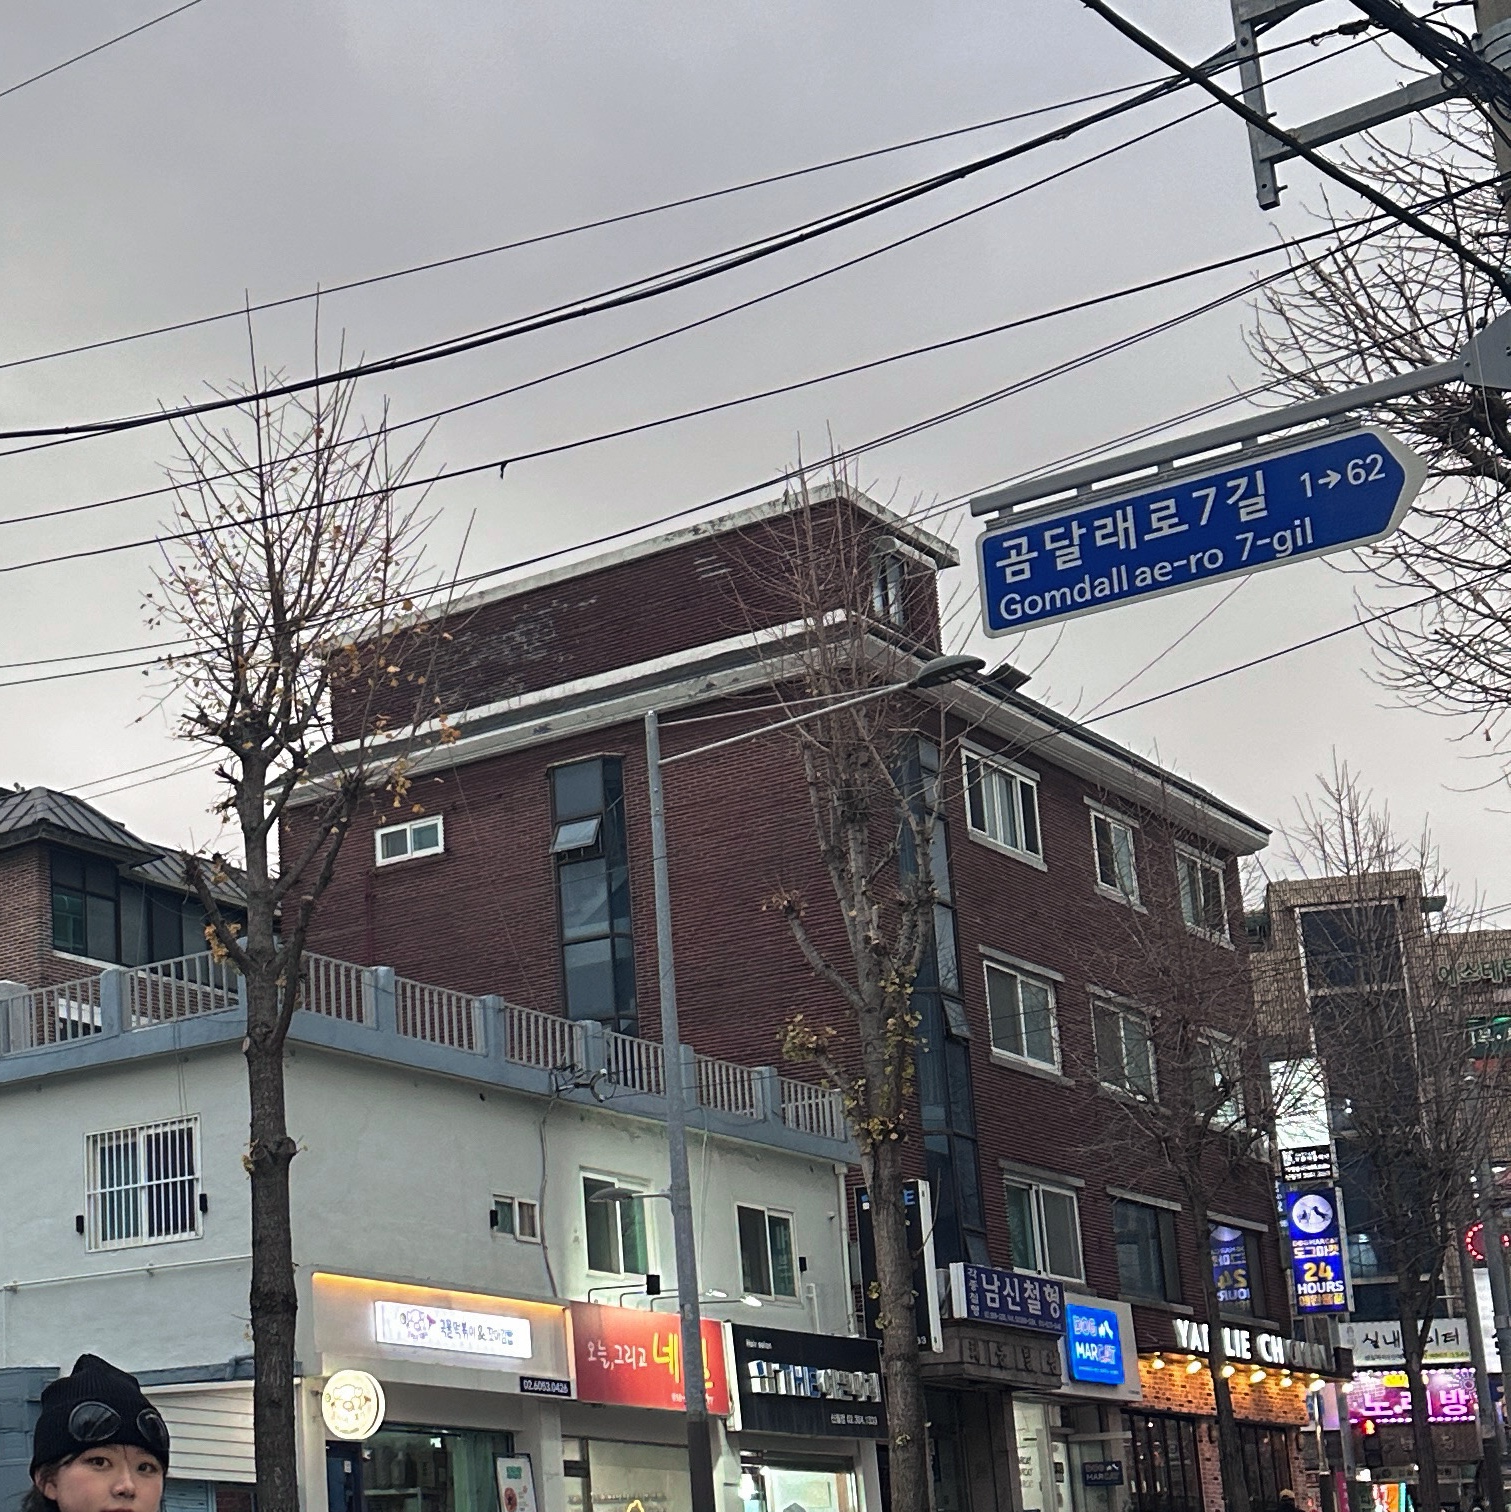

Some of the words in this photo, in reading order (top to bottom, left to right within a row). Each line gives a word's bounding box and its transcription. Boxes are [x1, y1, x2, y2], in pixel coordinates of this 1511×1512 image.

[1346, 454, 1386, 485] 62
[995, 470, 1268, 584] 곰달래로7길
[1235, 516, 1314, 561] 7-gil
[1438, 958, 1511, 988] 에스테
[1303, 1261, 1334, 1282] 24
[980, 1273, 1061, 1319] 남신철형
[1297, 1280, 1345, 1295] HOURS
[1072, 1315, 1098, 1337] DOG
